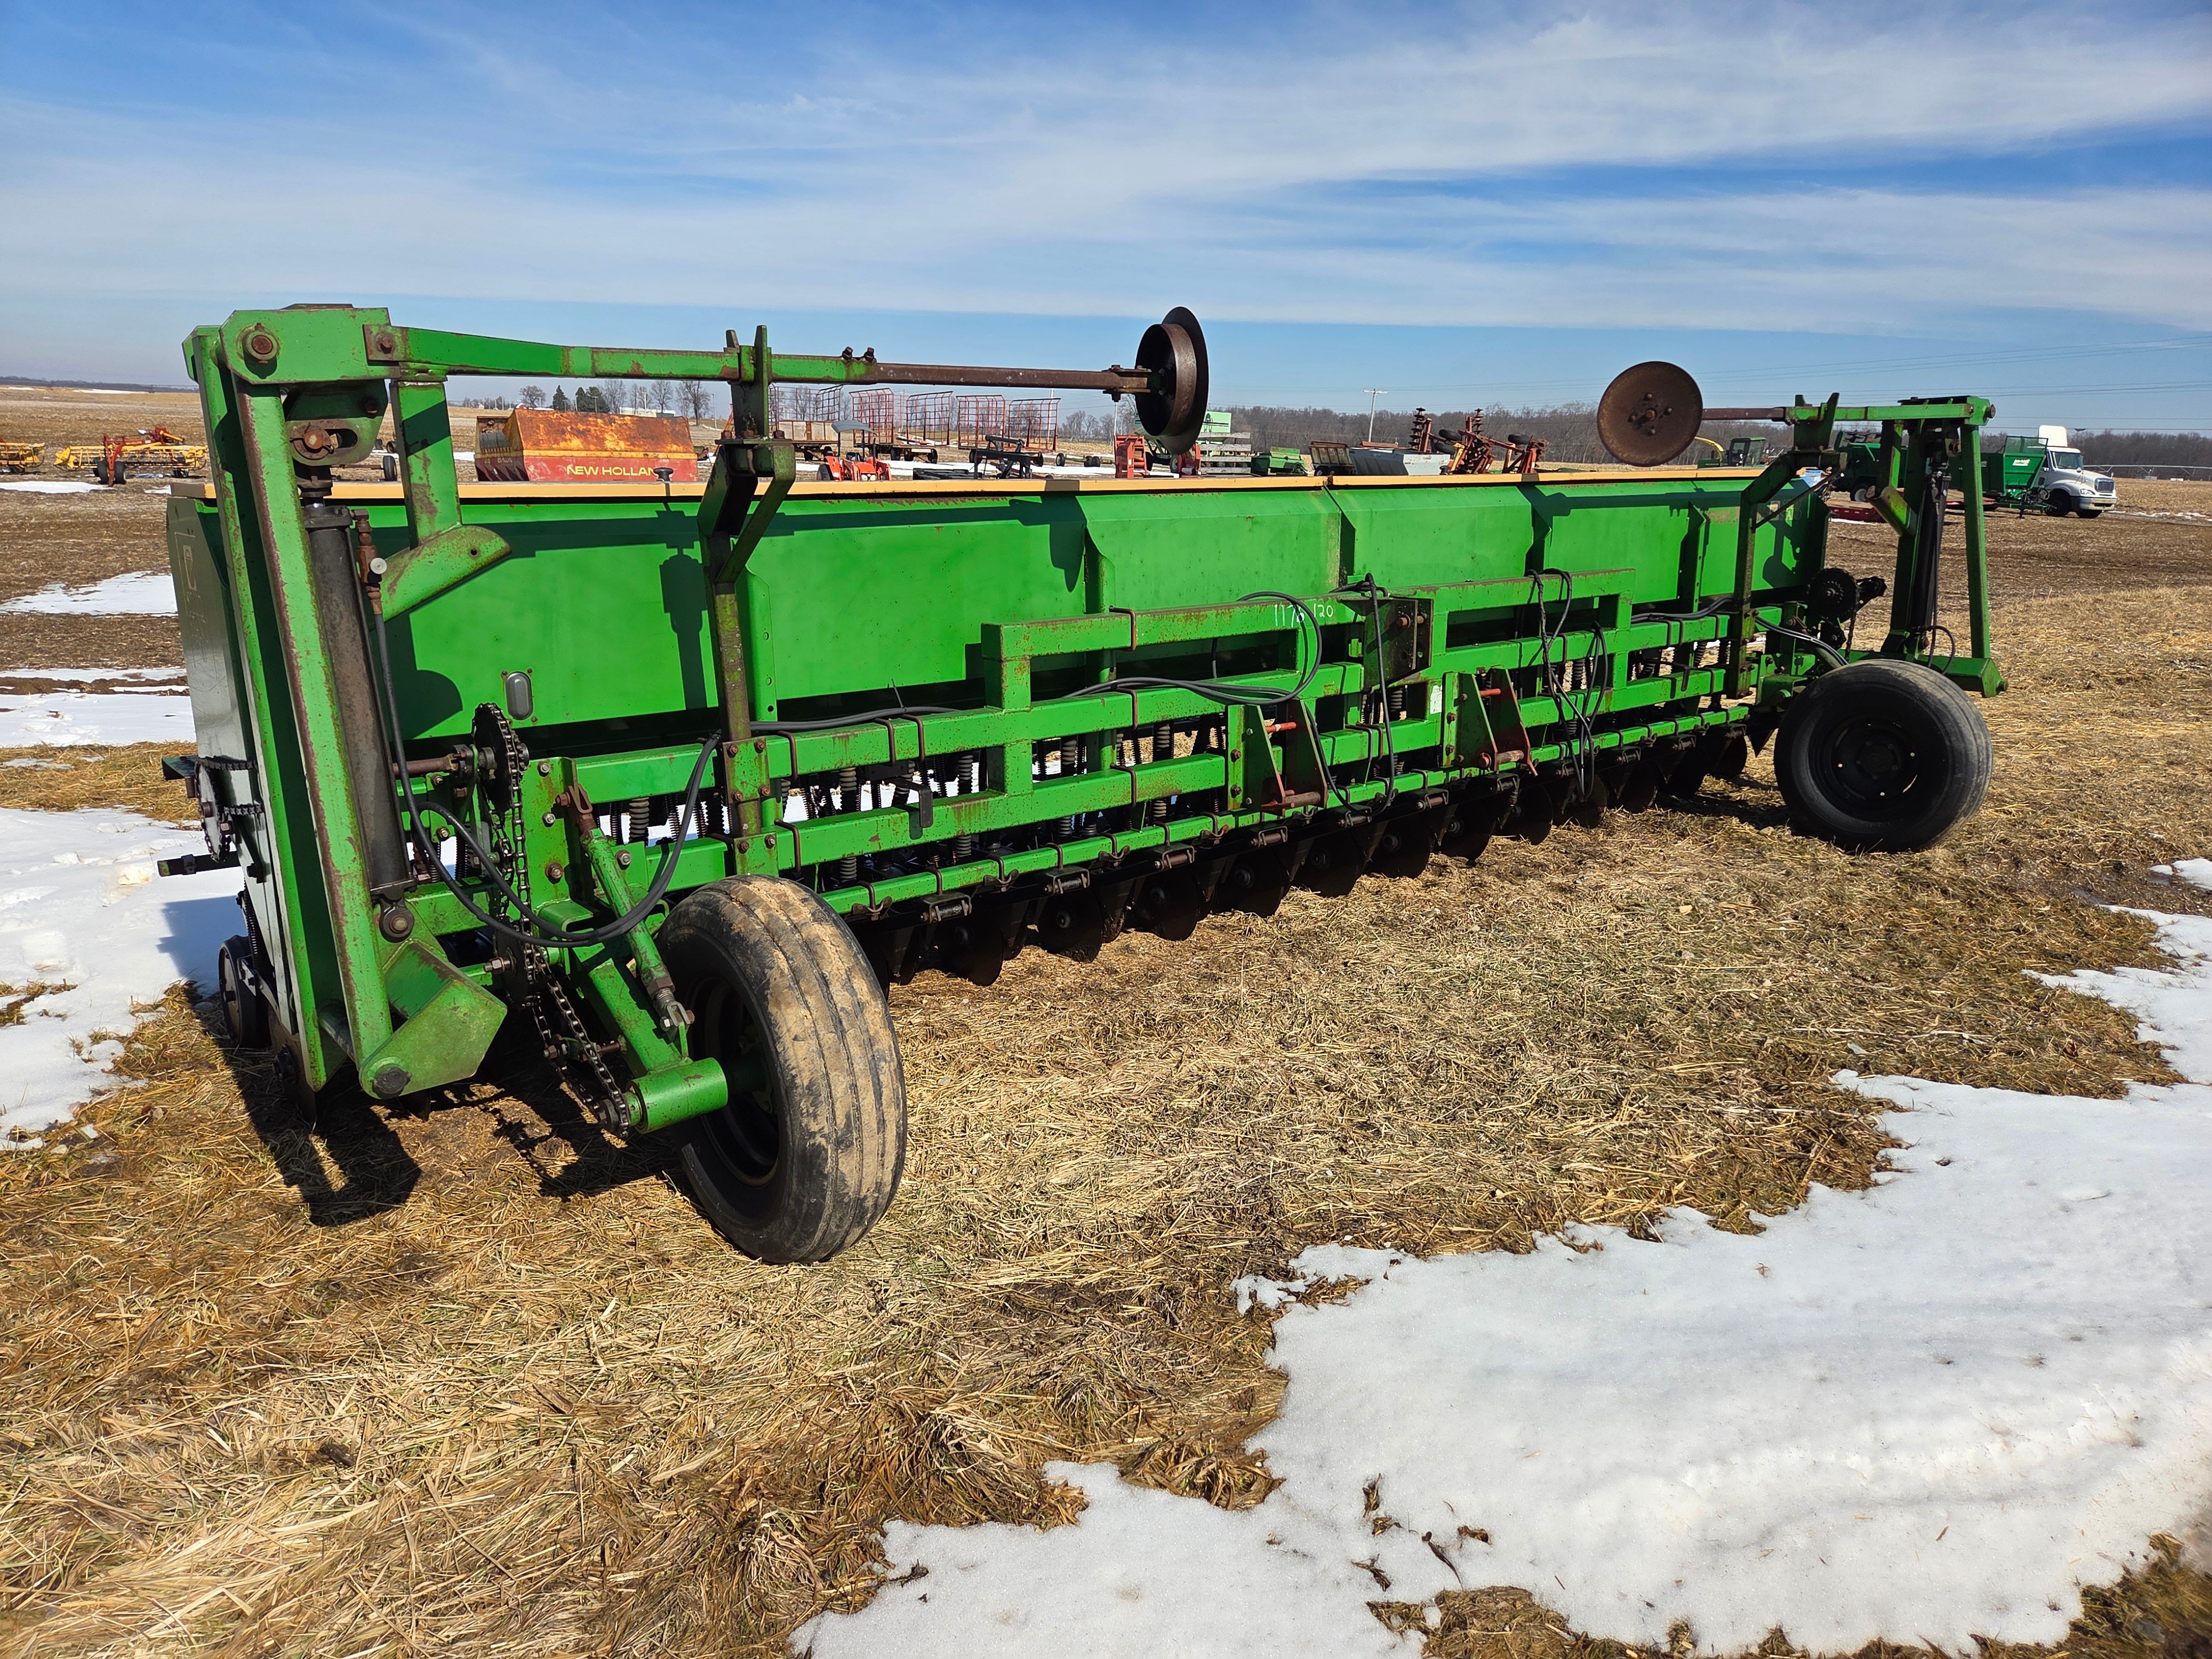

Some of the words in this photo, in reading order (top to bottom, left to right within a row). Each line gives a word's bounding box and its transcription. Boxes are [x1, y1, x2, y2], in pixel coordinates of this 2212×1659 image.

[566, 466, 599, 476] NEW
[601, 466, 656, 476] HOLLAN
[1313, 603, 1334, 618] 120
